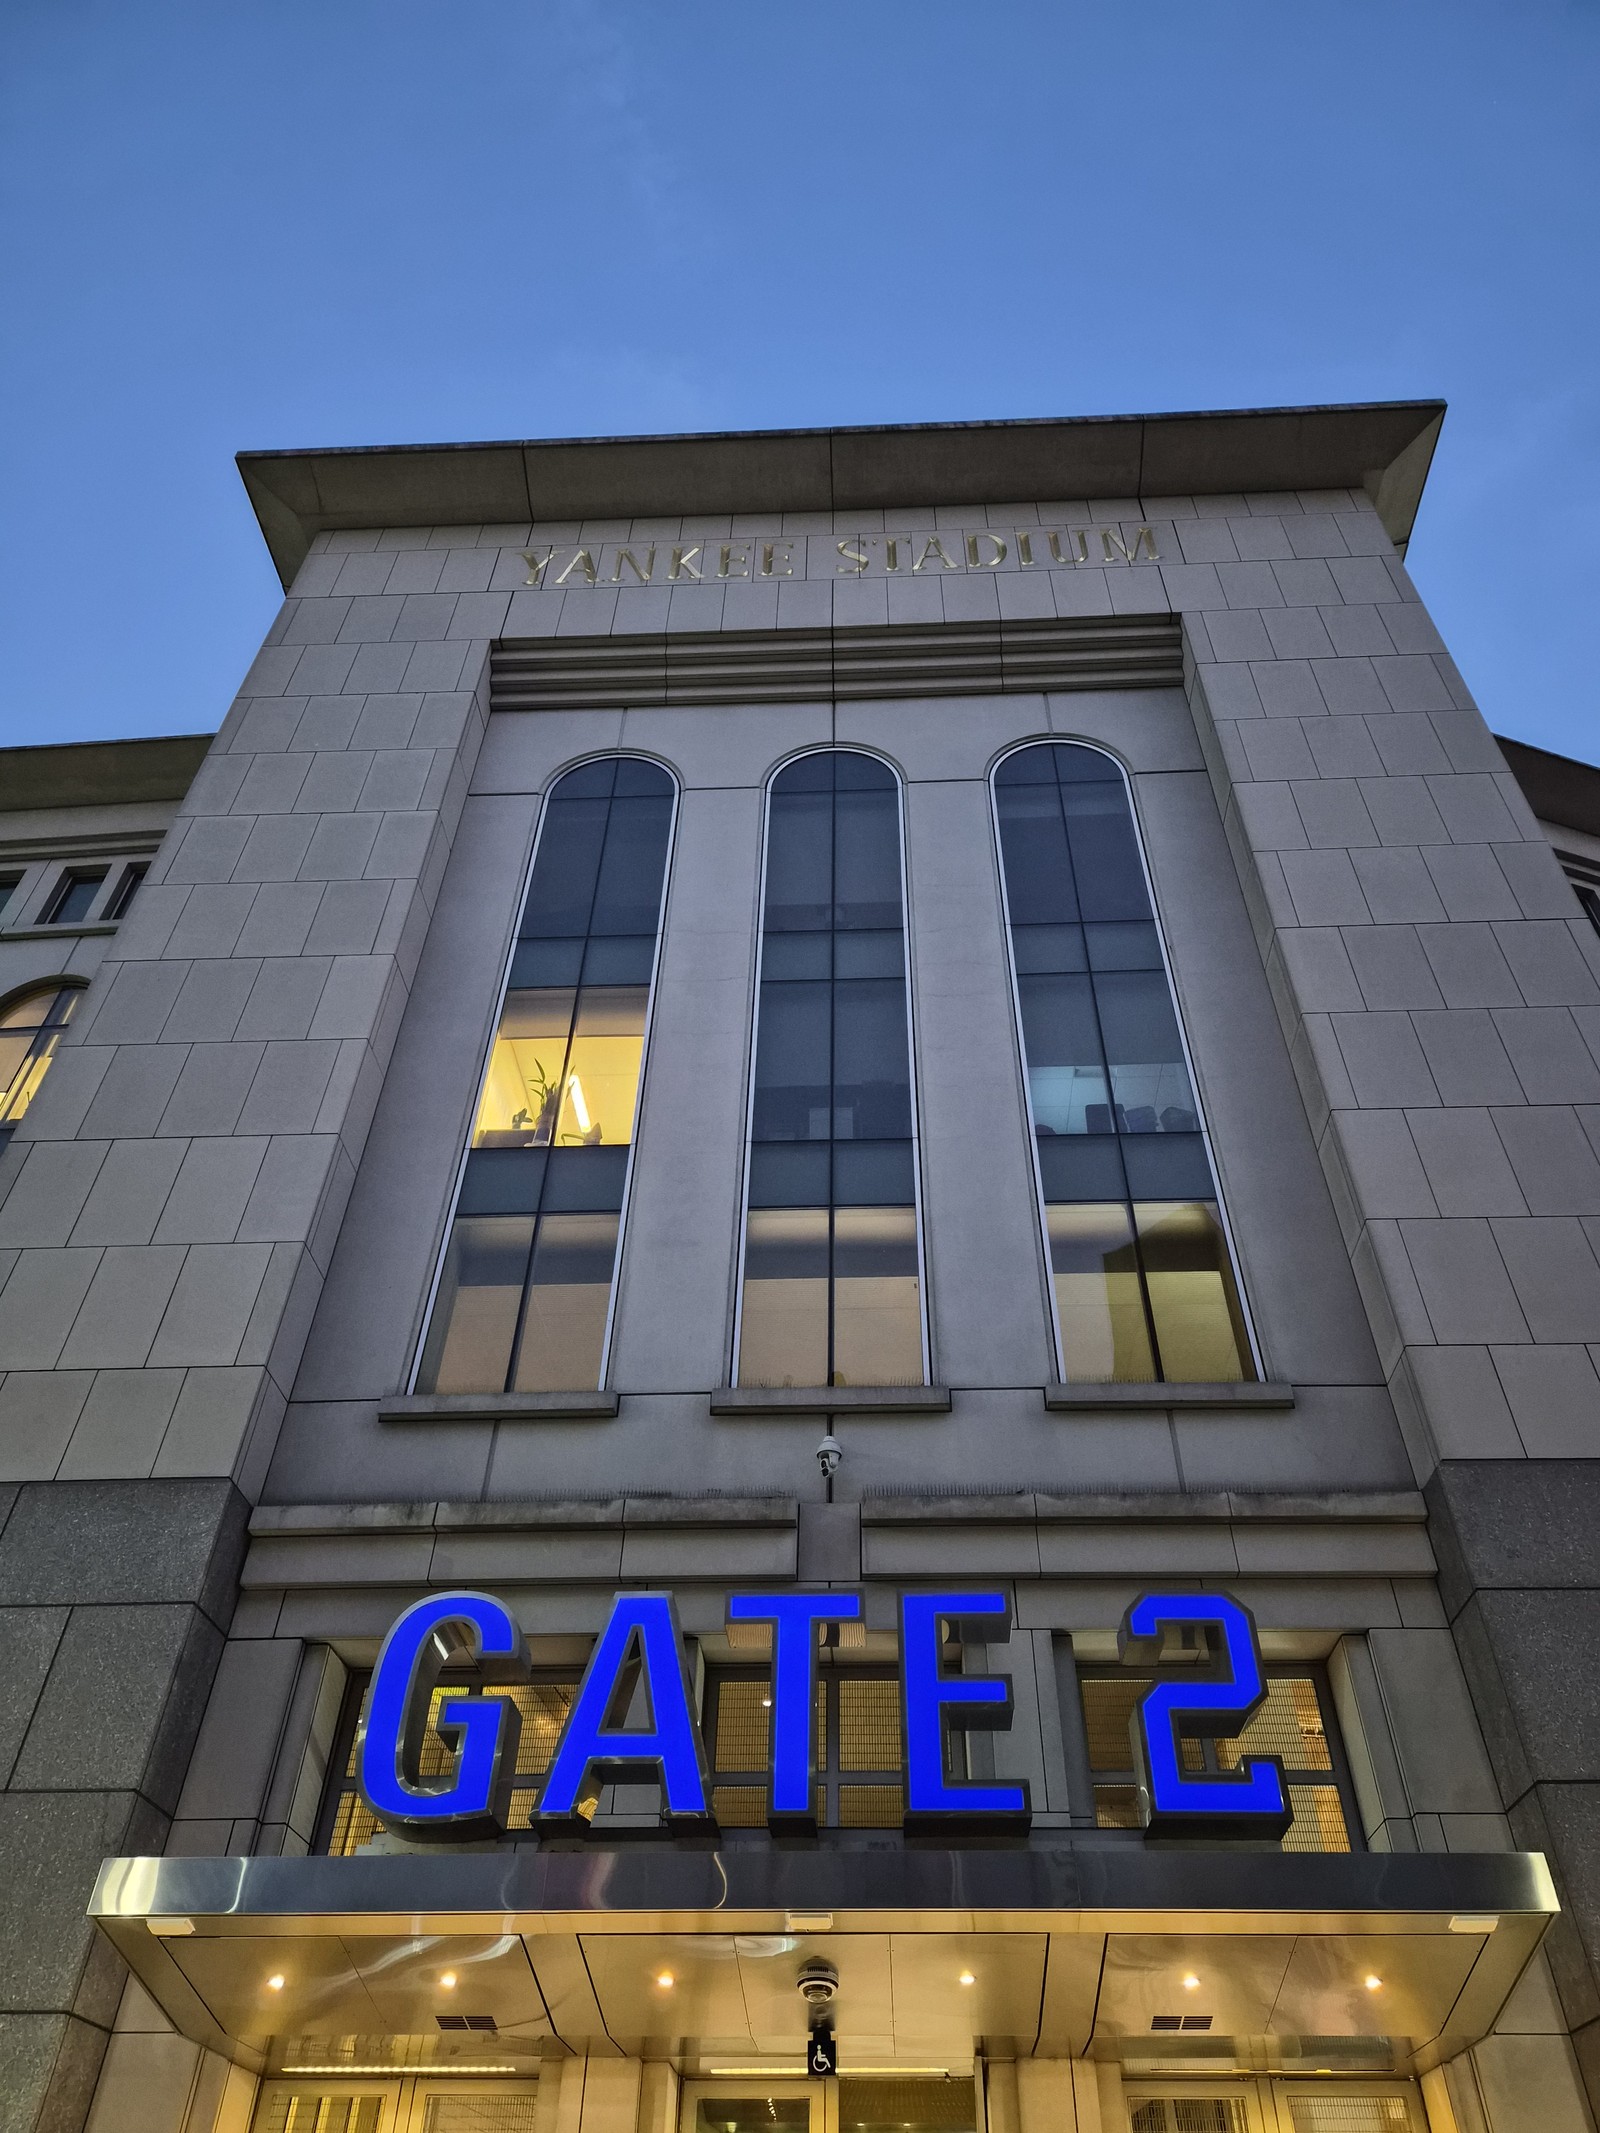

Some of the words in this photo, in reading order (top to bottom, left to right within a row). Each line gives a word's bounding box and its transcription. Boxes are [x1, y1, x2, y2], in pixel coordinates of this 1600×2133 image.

[521, 534, 796, 586] YANKEE
[834, 526, 1163, 574] STADIUM
[357, 1590, 1030, 1834] GATE
[1123, 1589, 1291, 1834] 2
